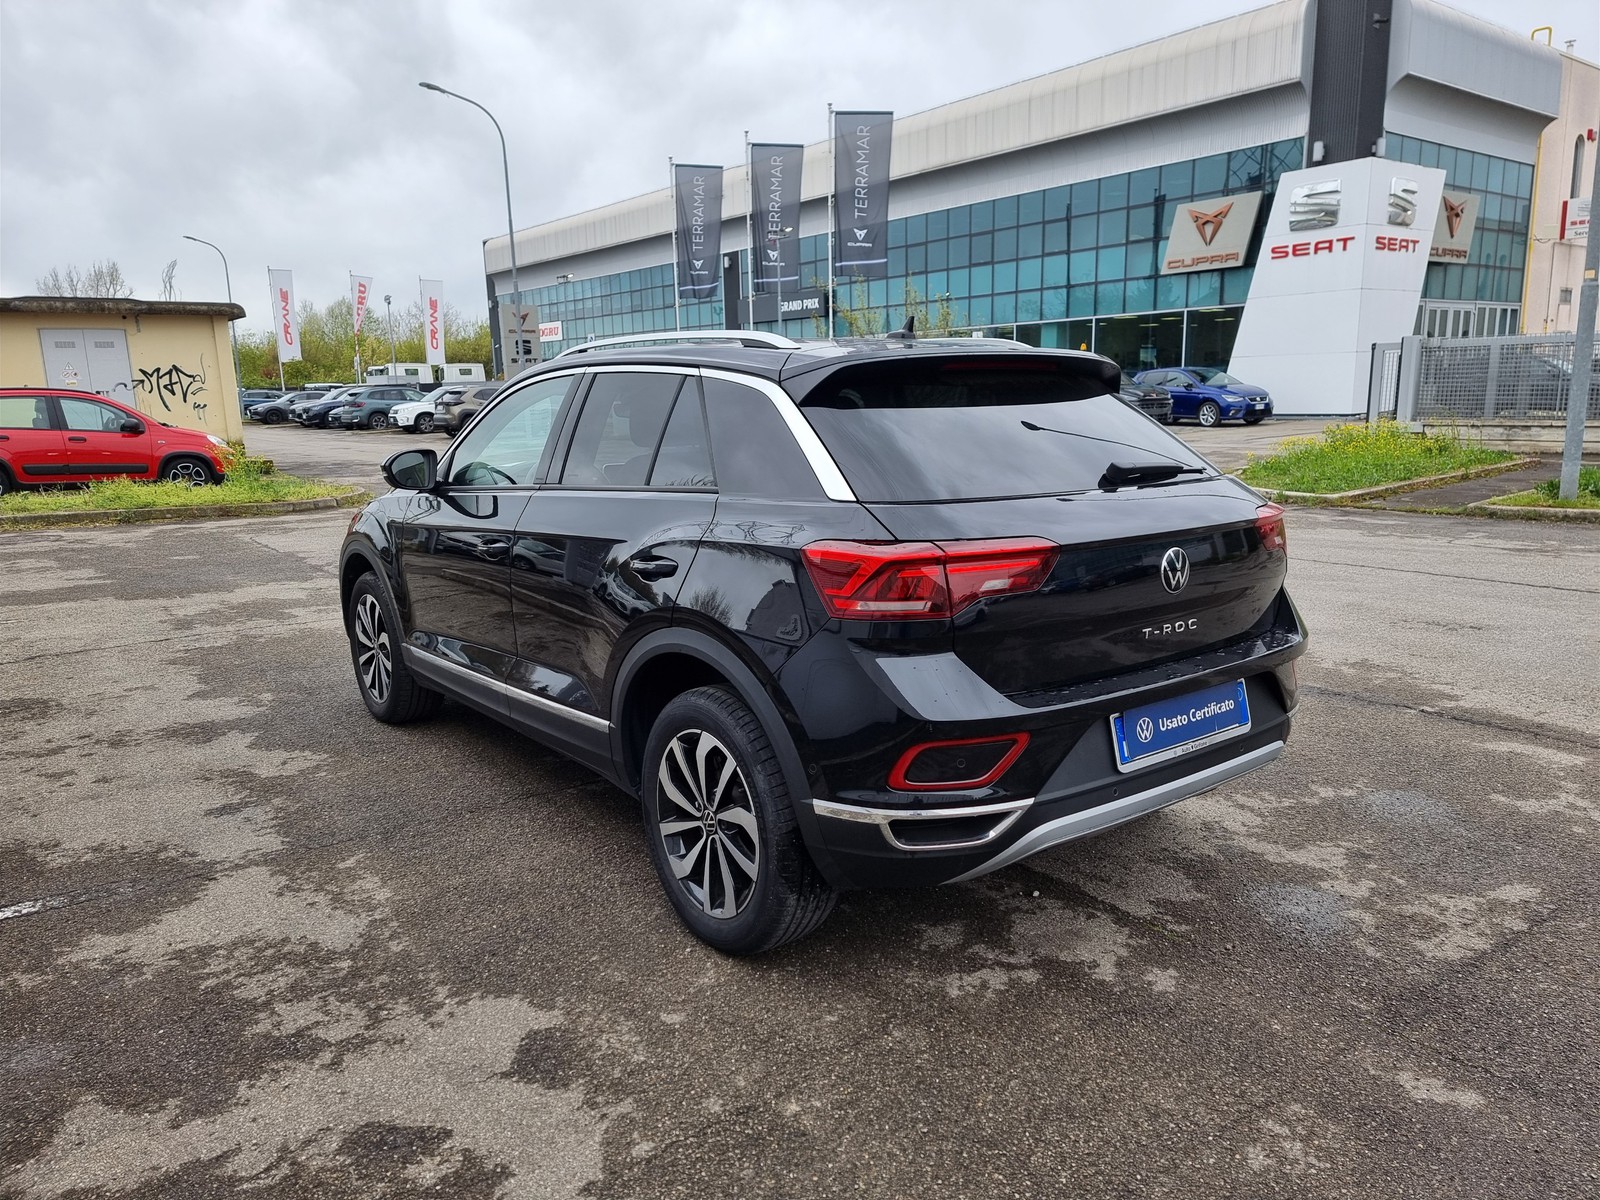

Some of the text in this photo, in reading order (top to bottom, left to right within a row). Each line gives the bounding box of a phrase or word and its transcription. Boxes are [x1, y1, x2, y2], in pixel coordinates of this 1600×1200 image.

[854, 124, 871, 219] TERRAMAR
[692, 175, 705, 252] TERRAMAR
[1270, 236, 1356, 260] SEAT
[1375, 235, 1420, 253] SEAT
[1166, 251, 1240, 270] CUPRA
[279, 287, 294, 346] CRANE
[780, 298, 819, 312] GRAND PRIX
[429, 296, 439, 350] CRANE
[1142, 618, 1198, 639] T-ROC
[1159, 715, 1188, 731] Usato
[1189, 699, 1235, 722] Certificato
